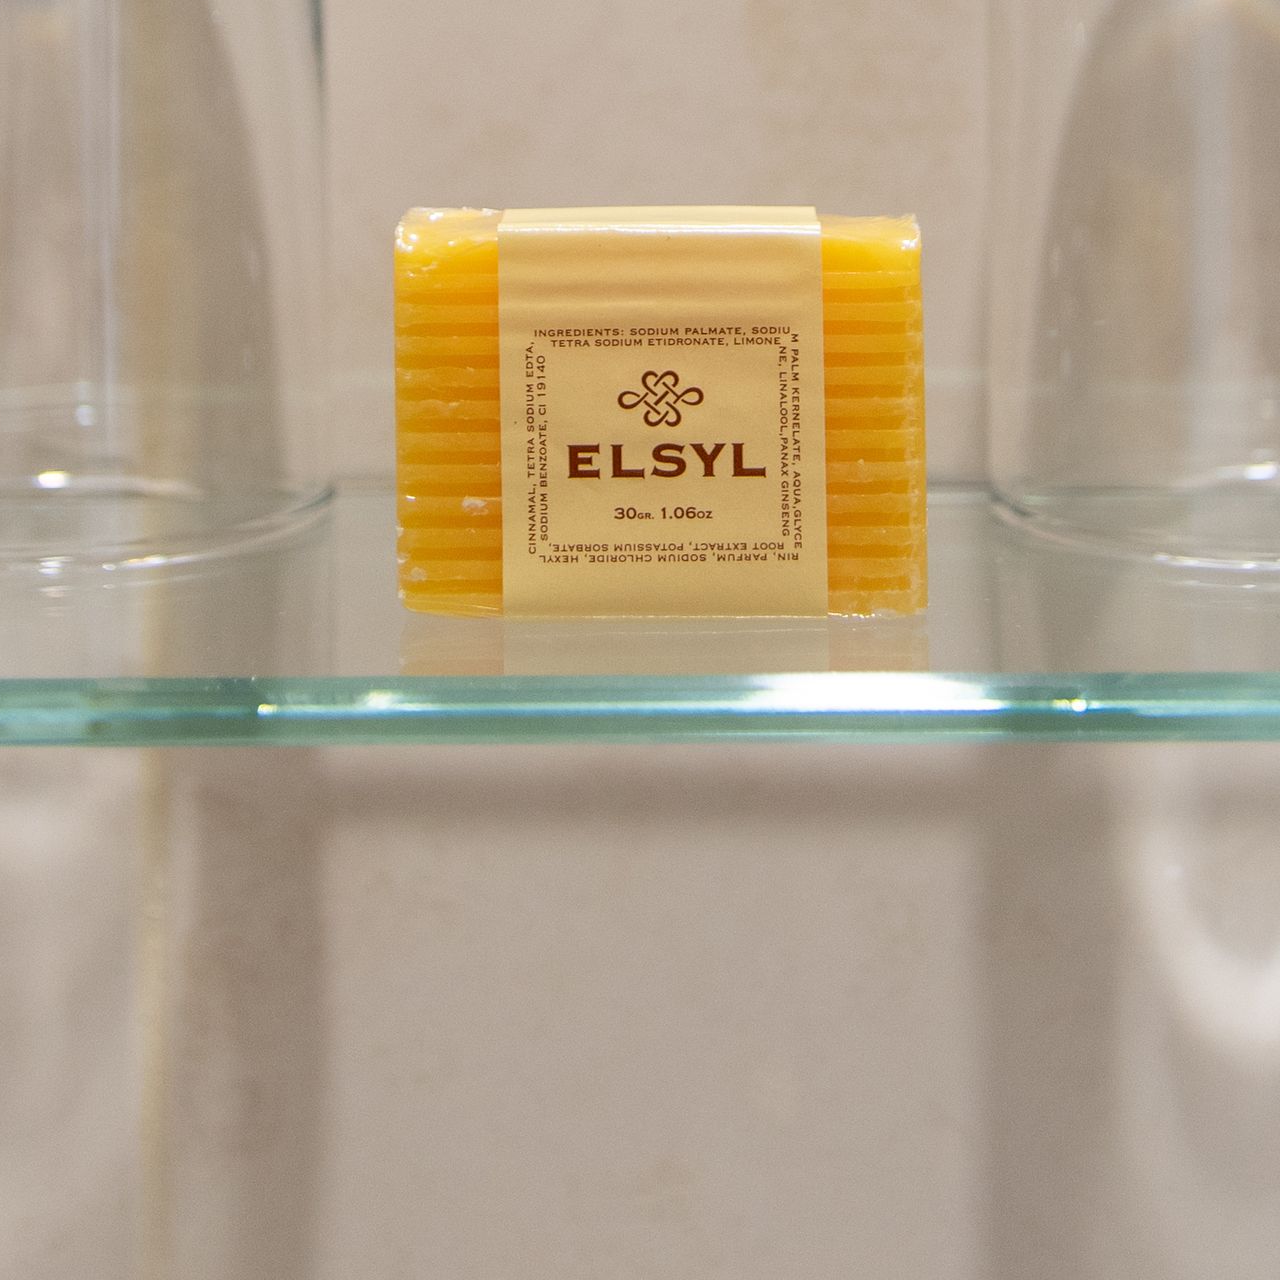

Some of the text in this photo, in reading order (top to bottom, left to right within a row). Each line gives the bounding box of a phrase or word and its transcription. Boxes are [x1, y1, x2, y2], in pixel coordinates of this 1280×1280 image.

[534, 326, 791, 337] INGREDIENTS: SODIUM PALMATE, SODIU
[551, 337, 781, 347] TETRA SODIUM ETIDRONATE, LIMONE
[778, 346, 787, 367] NE,
[791, 349, 799, 381] PALM
[792, 387, 801, 465] KERNELATE,
[526, 342, 537, 554] CINNAMAL, TETRA SODIUM EDTA,
[537, 355, 548, 541] SODIUM BENZOATE, CI 19140
[567, 443, 767, 479] ELSYL
[781, 480, 790, 536] GINSENG
[539, 552, 799, 563] RIN, PARFUM, SODIUM CHLORIDE, HEXYL
[549, 541, 784, 551] ROOT EXTRACT, POTASSIUM SORBATE,
